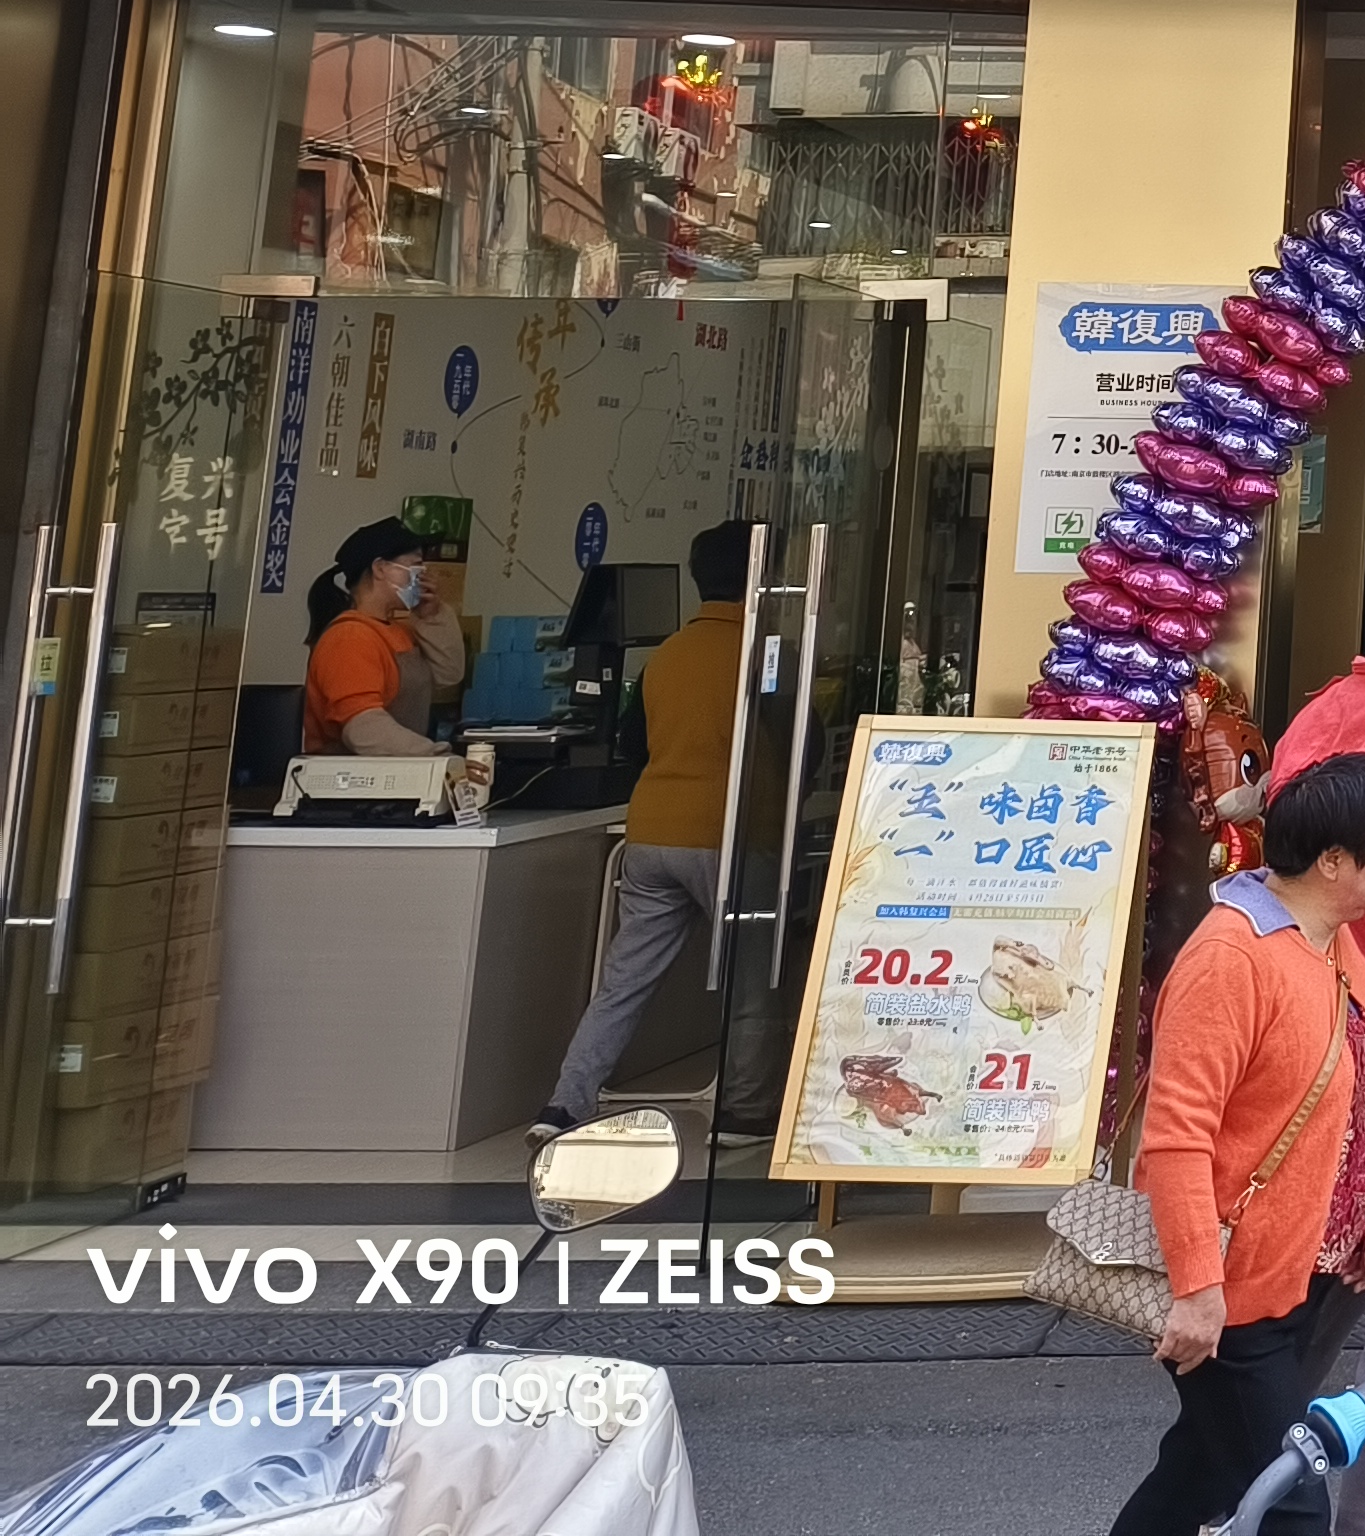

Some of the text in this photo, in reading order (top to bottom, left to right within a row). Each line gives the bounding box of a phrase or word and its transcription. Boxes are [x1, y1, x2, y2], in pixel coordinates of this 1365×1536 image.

[1072, 308, 1205, 344] 韓復興
[319, 314, 356, 467] 六朝佳品
[1096, 372, 1175, 394] 营业时间
[1100, 399, 1138, 407] BUSINESS
[263, 306, 316, 589] 南洋劝业会金奖
[879, 742, 947, 762] 韓復興
[853, 948, 954, 986] 20.2
[864, 991, 973, 1016] 简装盐水鸭
[978, 1052, 1032, 1091] 21
[962, 1097, 1051, 1123] 简装酱鸭
